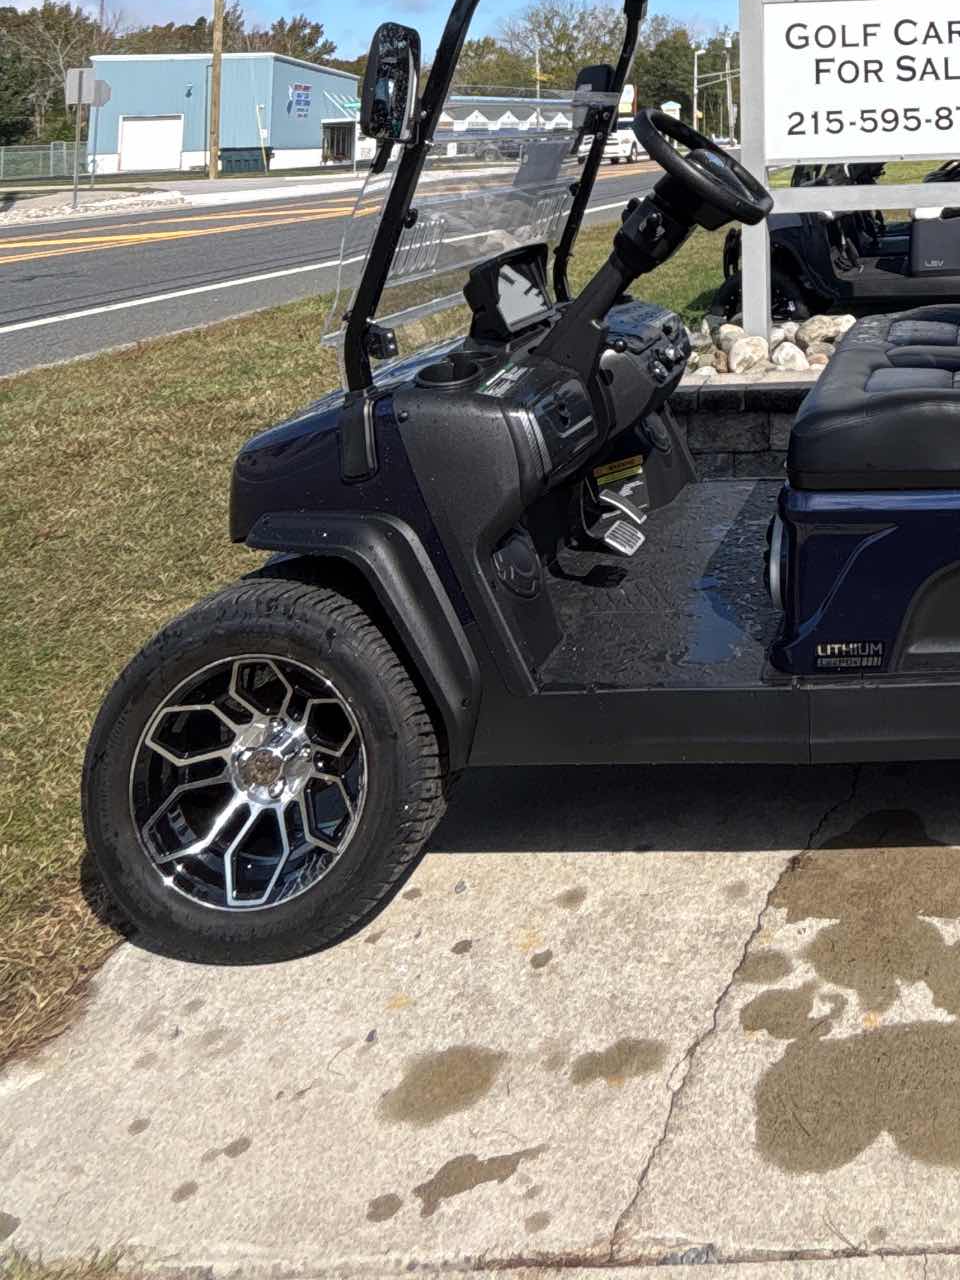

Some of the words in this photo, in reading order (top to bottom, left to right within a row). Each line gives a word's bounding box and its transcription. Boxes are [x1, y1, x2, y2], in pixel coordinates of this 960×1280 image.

[785, 23, 881, 49] GOLF
[815, 57, 884, 84] FOR
[817, 642, 882, 656] LITHIUM
